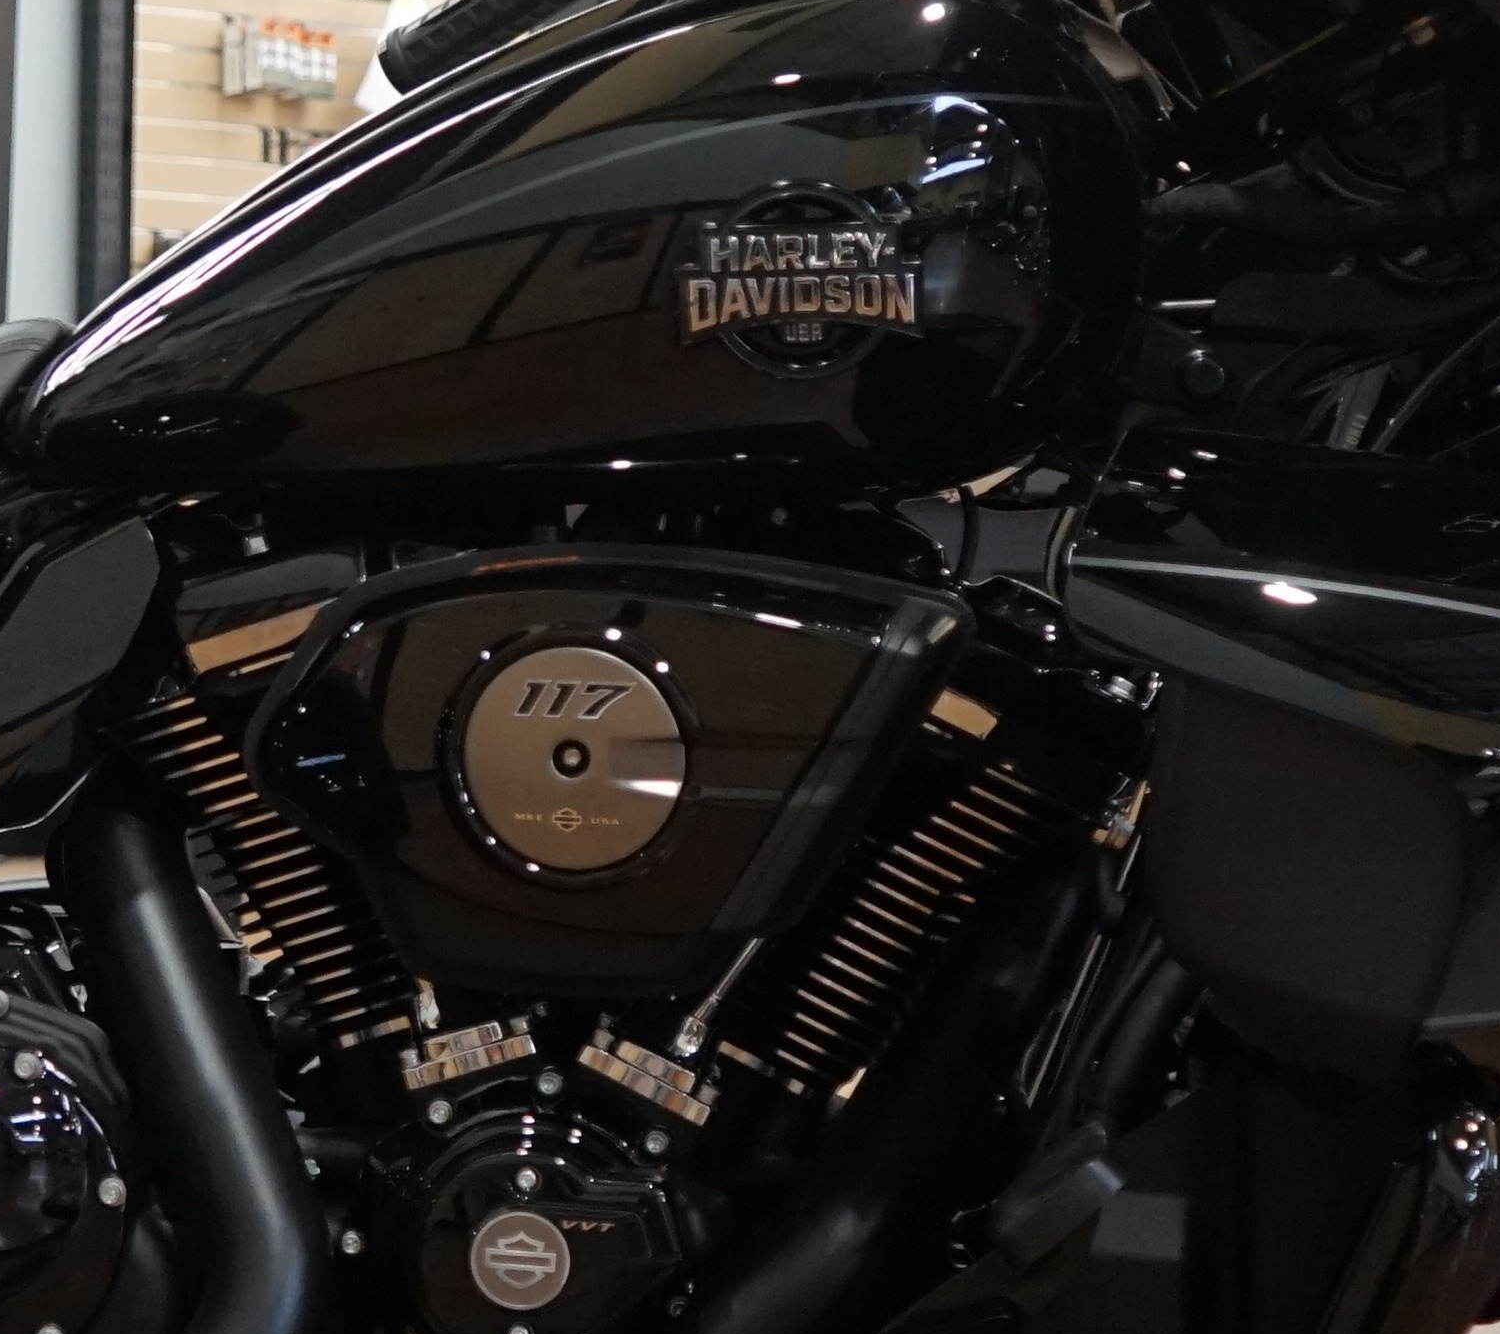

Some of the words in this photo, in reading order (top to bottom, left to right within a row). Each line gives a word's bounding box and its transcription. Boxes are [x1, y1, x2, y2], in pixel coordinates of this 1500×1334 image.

[709, 231, 896, 274] HARLEY-
[688, 273, 916, 334] DAVIDSON
[784, 323, 824, 343] USA
[513, 678, 637, 720] 117
